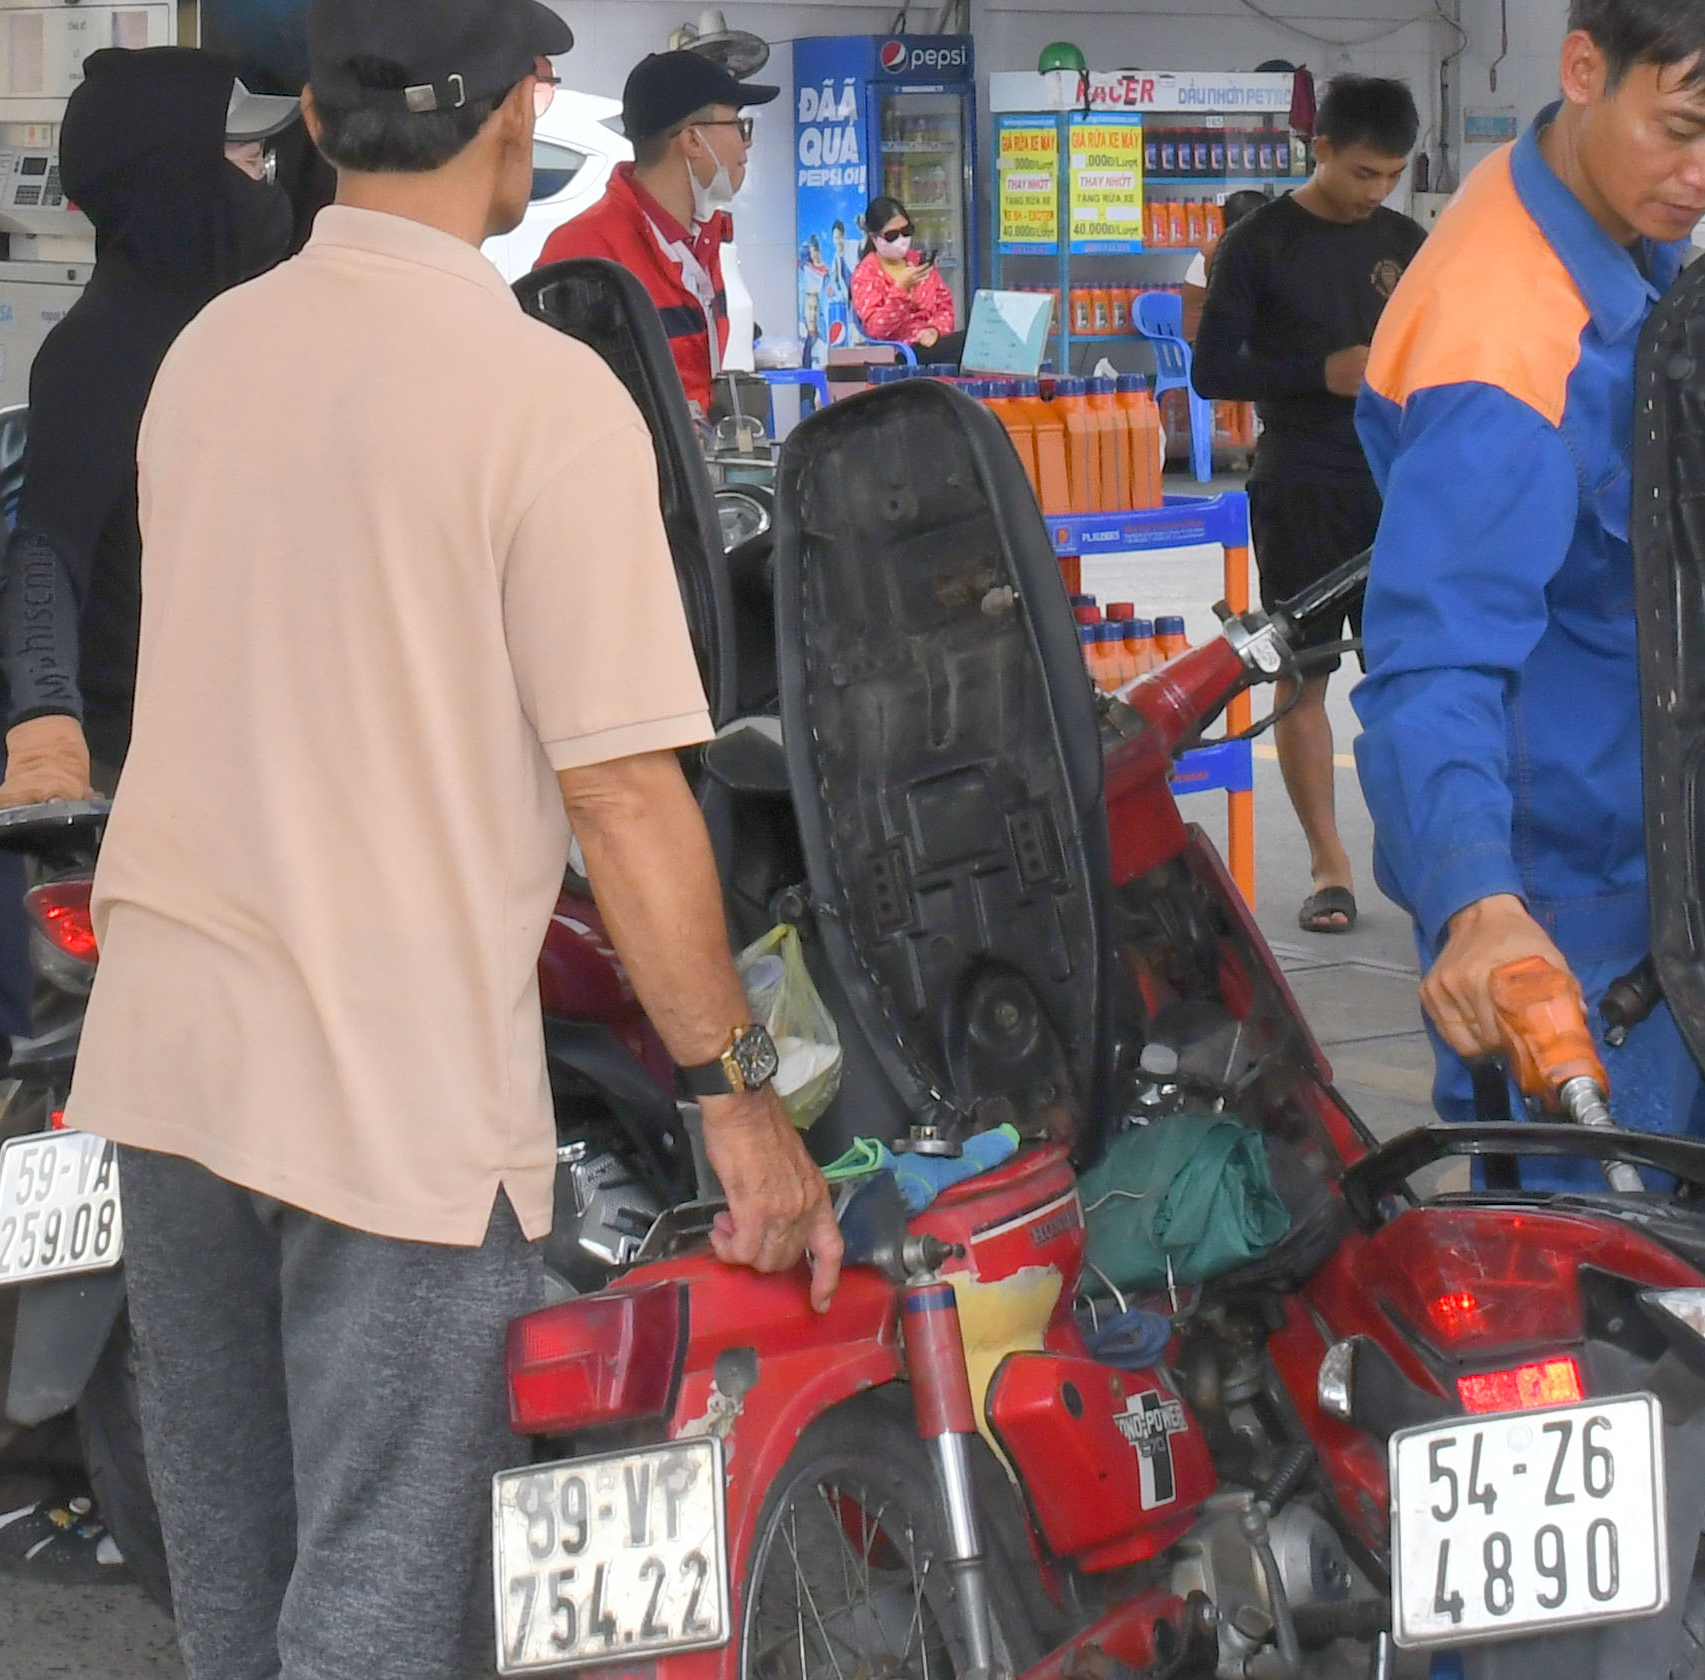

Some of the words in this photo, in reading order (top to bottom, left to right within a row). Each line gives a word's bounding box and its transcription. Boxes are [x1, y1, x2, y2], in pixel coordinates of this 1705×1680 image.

[911, 45, 966, 69] pepsi
[799, 120, 859, 167] QUÁ
[1109, 131, 1119, 148] XE
[798, 169, 843, 187] PEPSI
[1080, 175, 1103, 187] THAY
[1428, 1415, 1615, 1523] 54-Z6
[1434, 1517, 1620, 1624] 4890
[510, 1549, 711, 1660] 754.22
